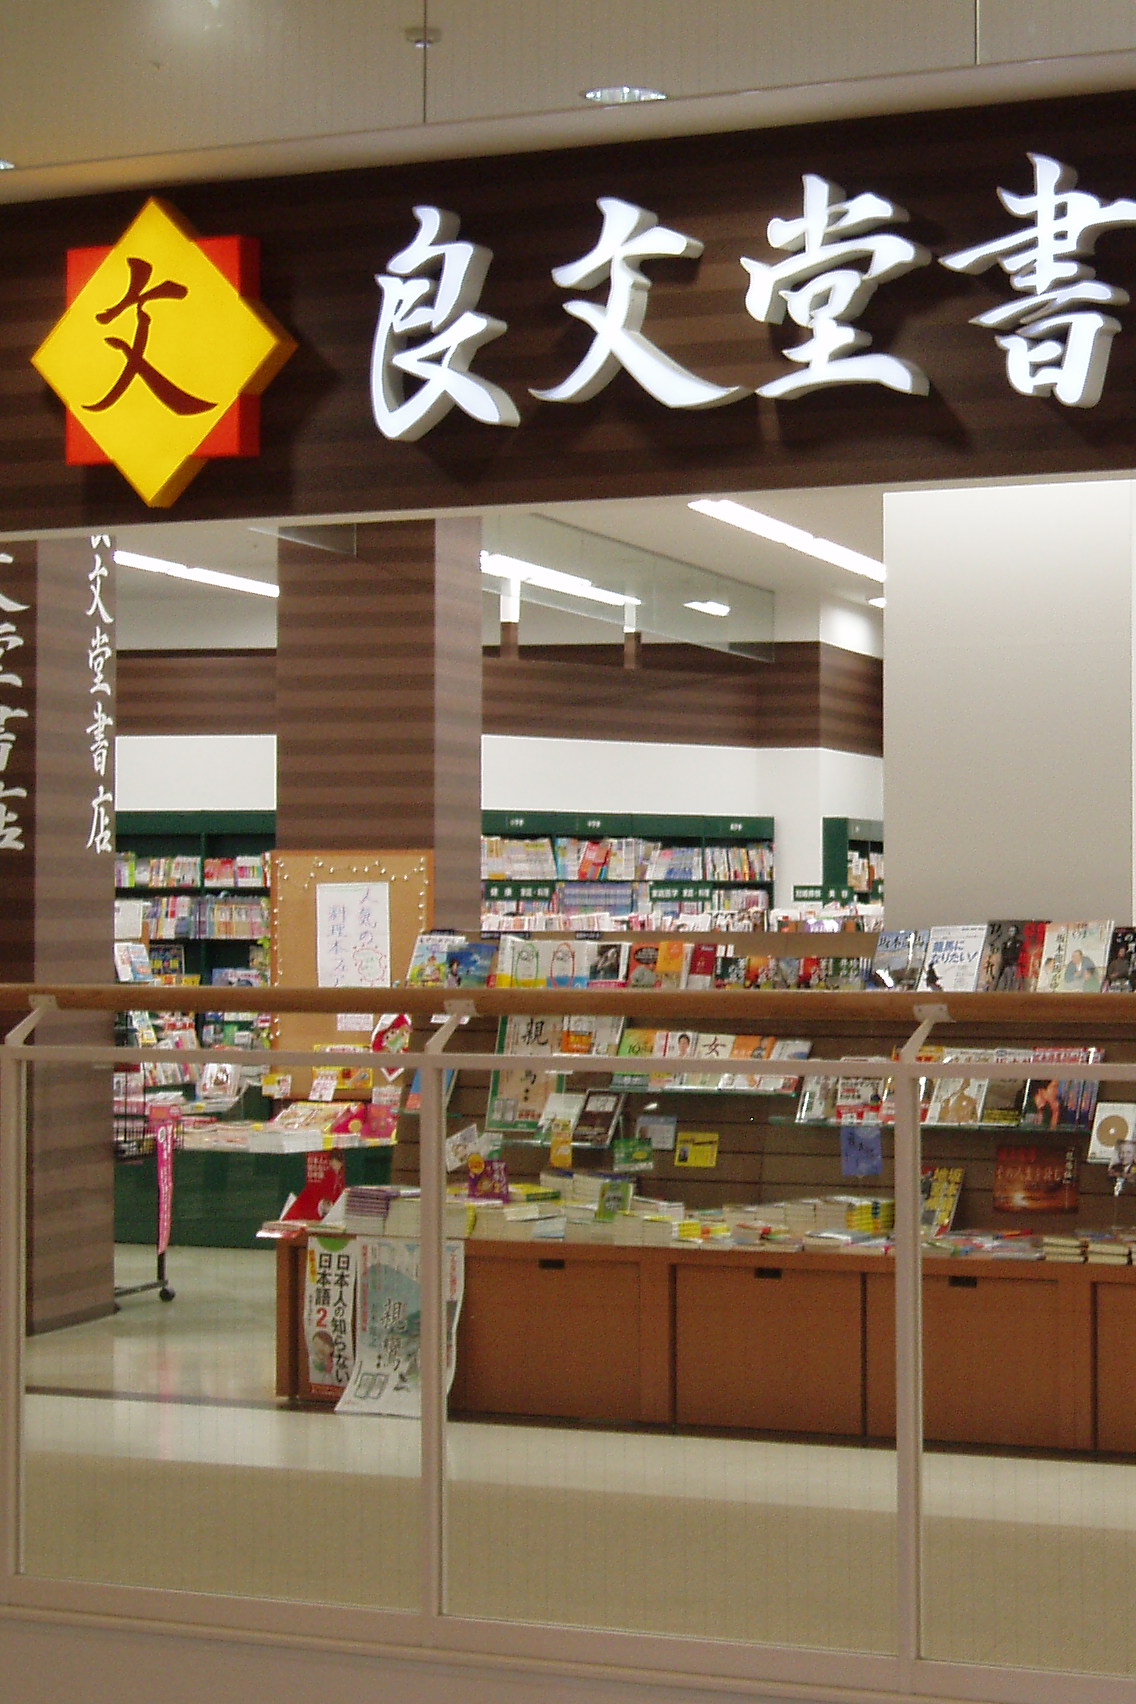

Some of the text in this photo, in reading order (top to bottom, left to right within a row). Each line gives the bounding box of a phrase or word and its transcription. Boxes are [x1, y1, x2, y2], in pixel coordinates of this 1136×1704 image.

[82, 257, 218, 417] 文
[86, 535, 114, 854] 文堂書店
[702, 1035, 726, 1058] 女
[315, 1253, 332, 1328] 日本語2
[331, 1254, 350, 1383] 日本人の知らない
